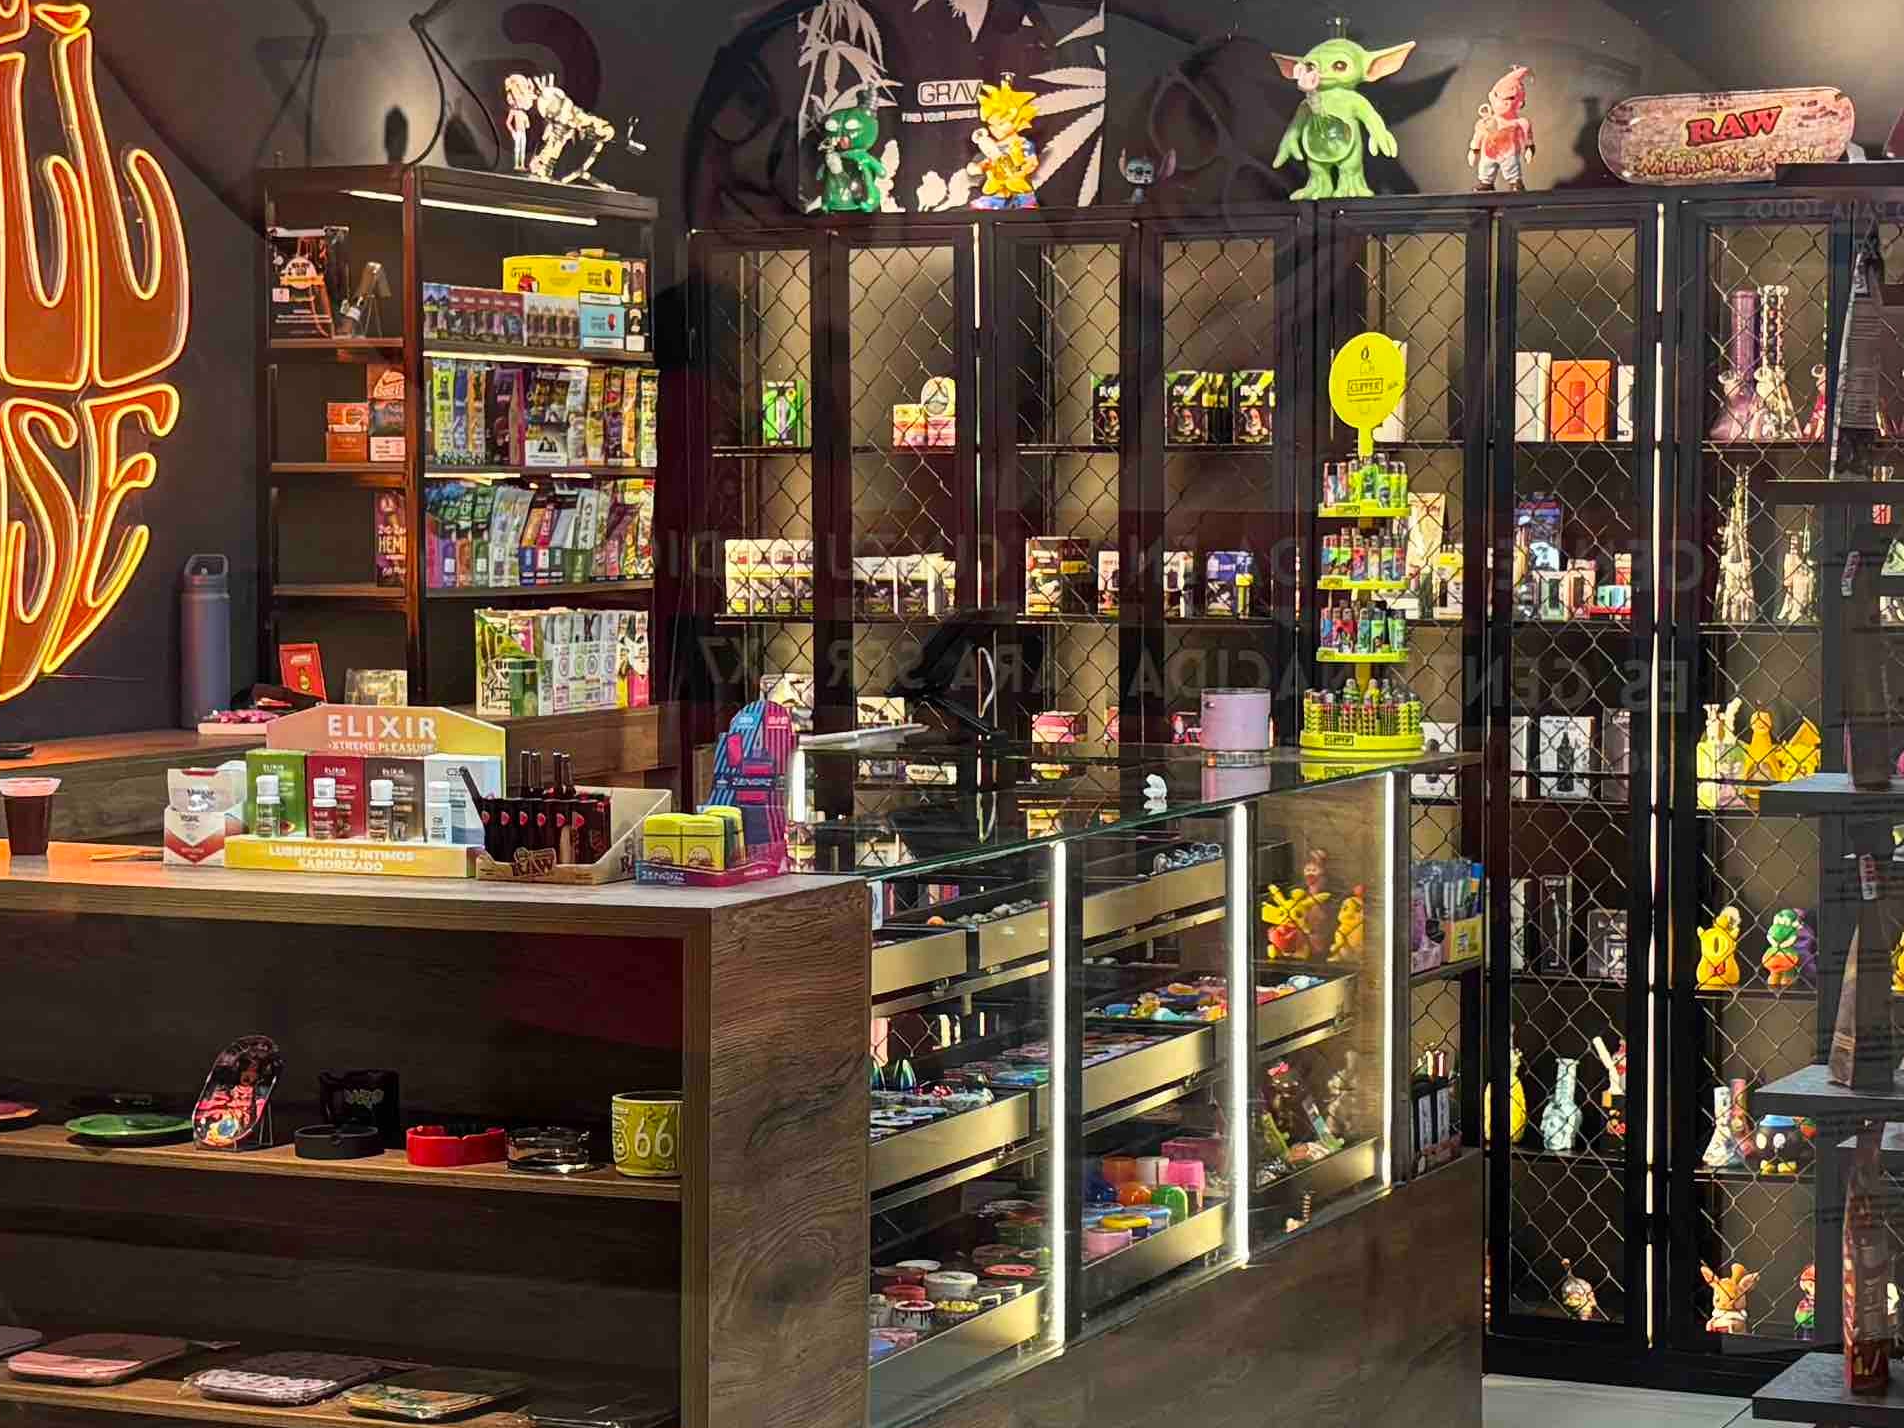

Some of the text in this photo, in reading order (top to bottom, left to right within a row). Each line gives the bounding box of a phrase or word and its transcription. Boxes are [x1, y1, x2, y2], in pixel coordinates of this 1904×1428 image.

[1686, 106, 1783, 147] RAW
[327, 713, 438, 741] ELIXIR
[268, 844, 357, 860] LUBRICANTES
[298, 858, 384, 872] SABORIZADO
[634, 1118, 674, 1160] 66
